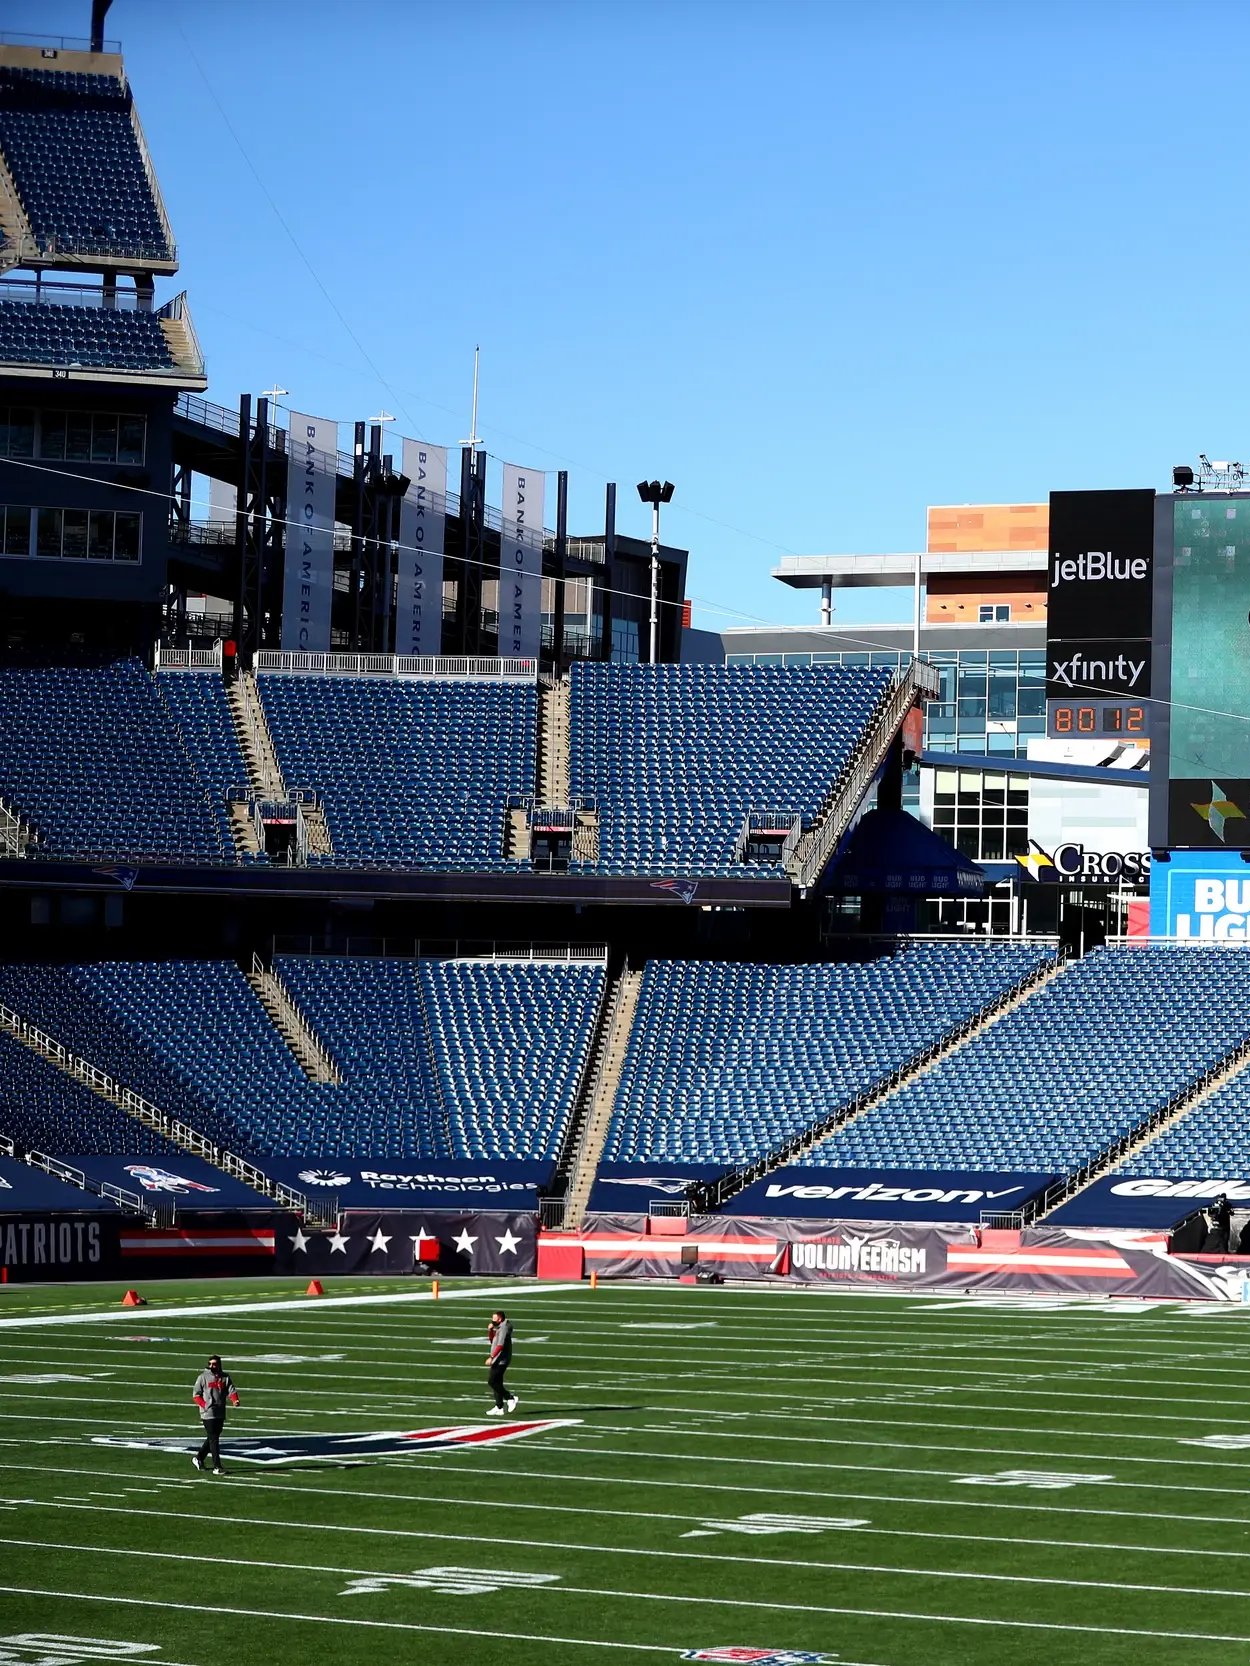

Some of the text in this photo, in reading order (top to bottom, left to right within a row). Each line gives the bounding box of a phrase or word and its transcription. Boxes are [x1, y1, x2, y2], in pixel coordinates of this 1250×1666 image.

[55, 370, 67, 378] 340
[304, 425, 315, 495] BANK
[416, 451, 427, 518] BANK
[515, 477, 526, 540] BANK
[1051, 551, 1147, 588] jetBlue
[1052, 653, 1146, 687] xfinity
[360, 1171, 495, 1183] Raytheon
[363, 1179, 538, 1193] Technologies
[765, 1183, 983, 1204] verizon
